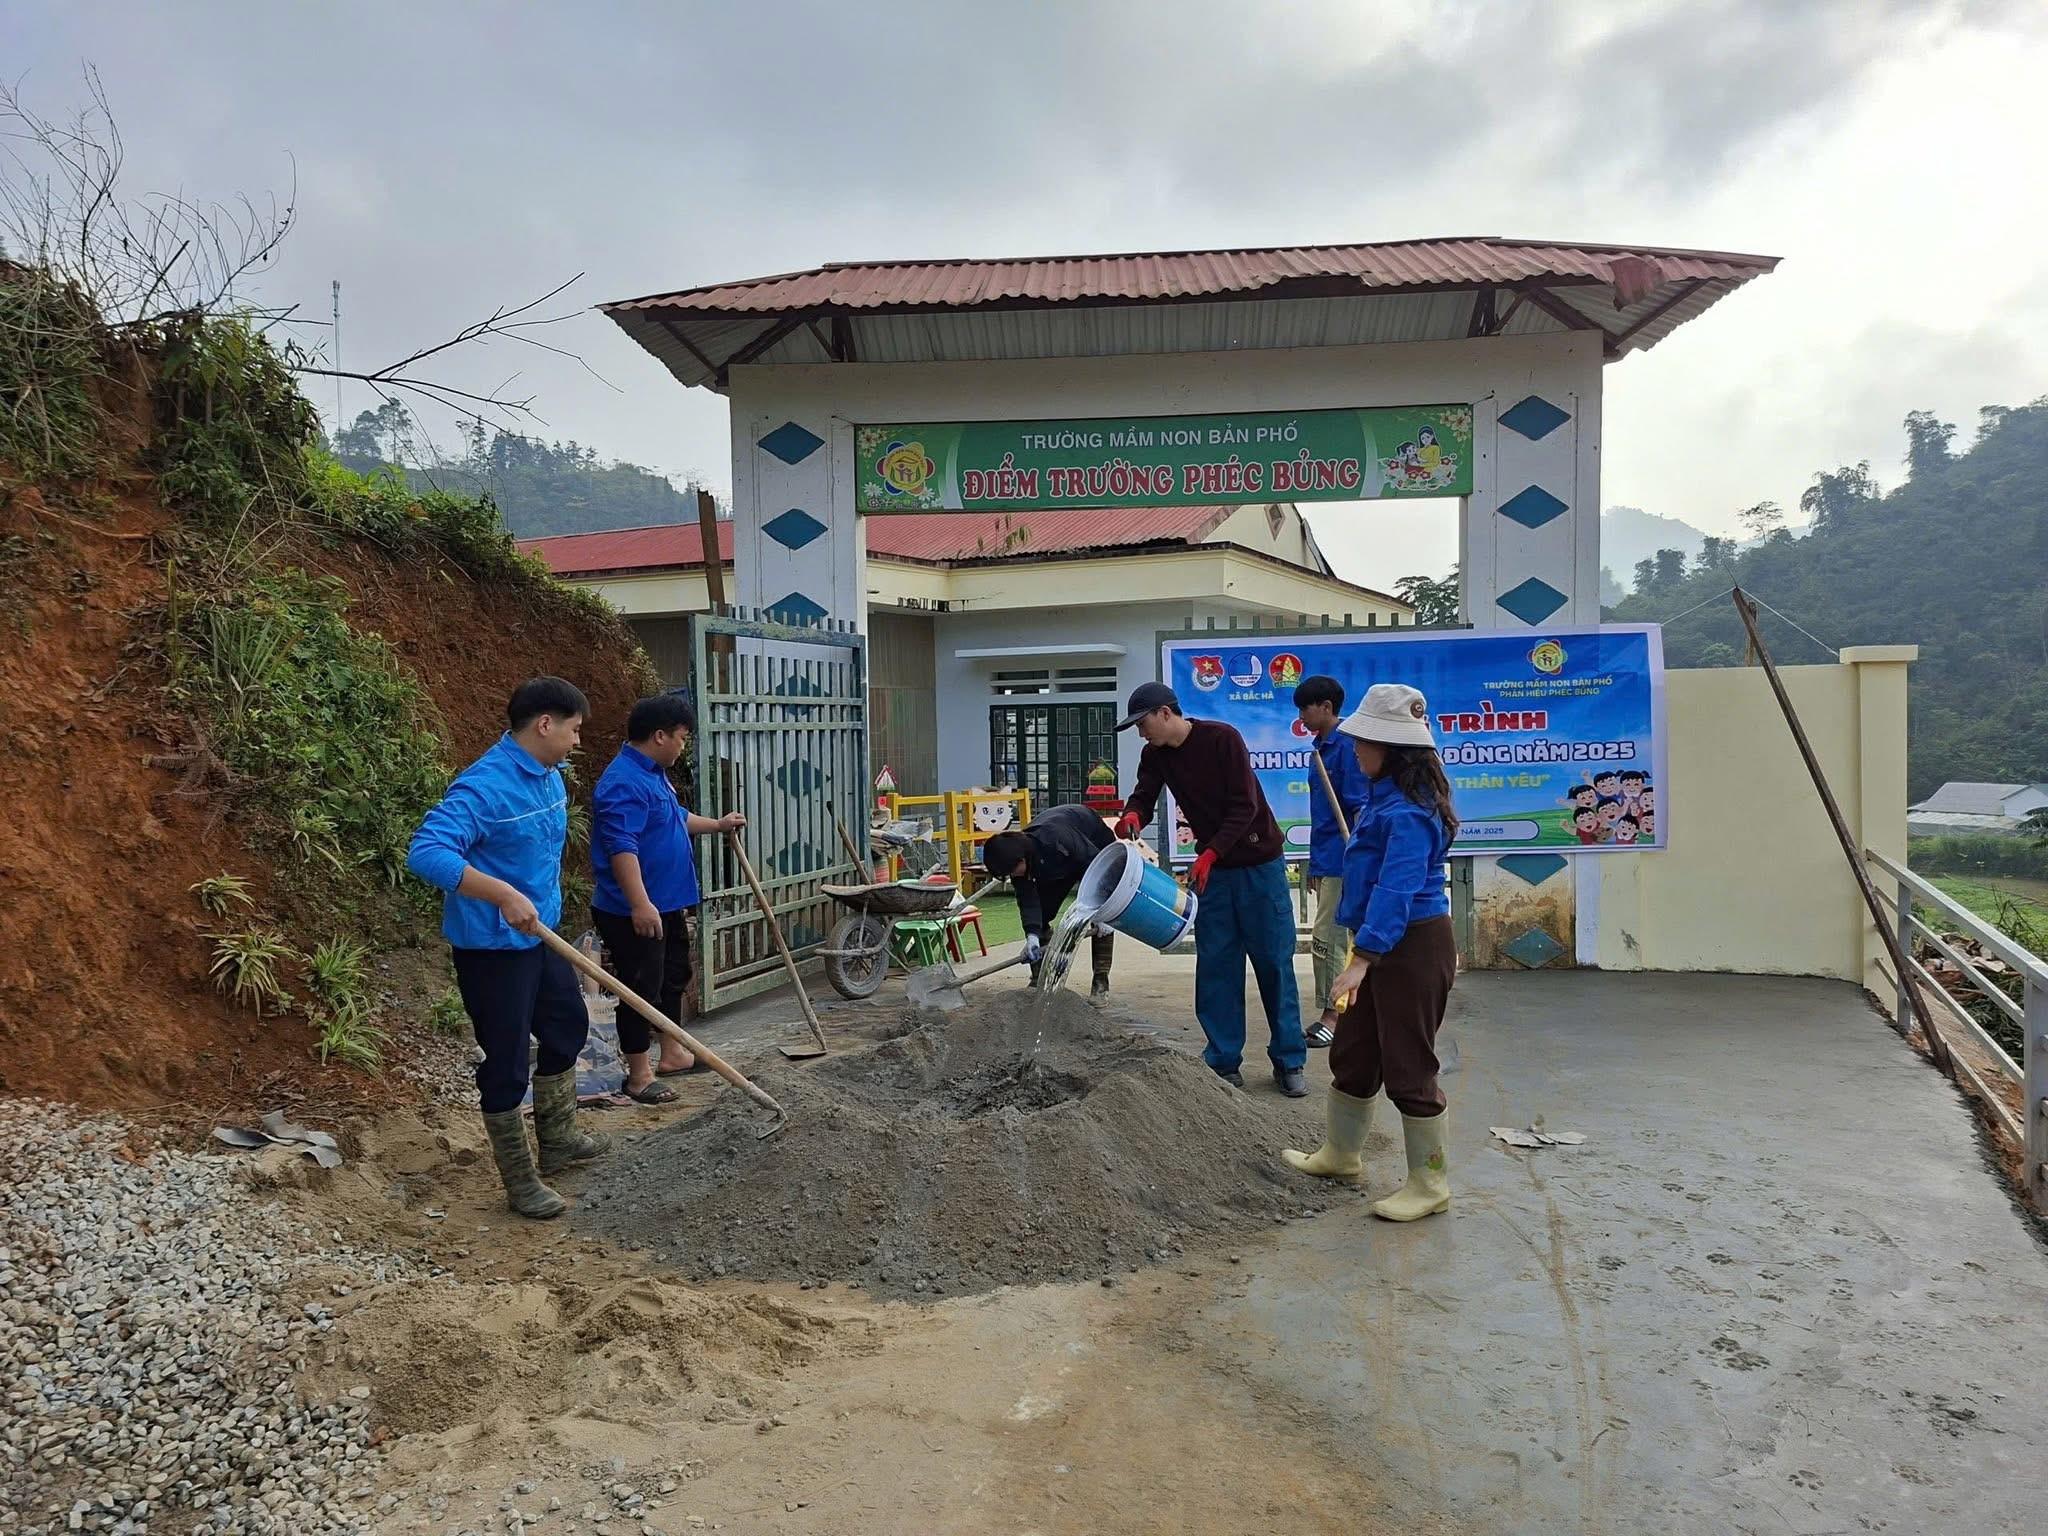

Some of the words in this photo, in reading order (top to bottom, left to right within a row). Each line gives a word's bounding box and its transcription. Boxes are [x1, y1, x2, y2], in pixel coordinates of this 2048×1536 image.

[1022, 430, 1103, 449] TRƯỜNG
[1109, 425, 1154, 447] MẦM
[1160, 430, 1201, 446] NON
[1208, 423, 1249, 444] BẢN
[1256, 420, 1299, 442] PHỐ
[963, 452, 1040, 500] ĐIỂM
[1047, 458, 1175, 497] TRƯỜNG
[1182, 454, 1263, 494] PHÉC
[1271, 448, 1361, 491] BỦNG
[1483, 680, 1524, 689] TRƯỜNG
[1549, 680, 1570, 688] NON
[1593, 674, 1613, 685] PHỐ
[1261, 690, 1274, 699] HÀ
[1438, 701, 1548, 733] TRÌNH
[1443, 741, 1512, 764] ĐÔNG
[1515, 739, 1569, 762] NĂM
[1572, 741, 1635, 761] 2025
[1455, 773, 1504, 789] THÂN
[1484, 827, 1504, 835] 2025
